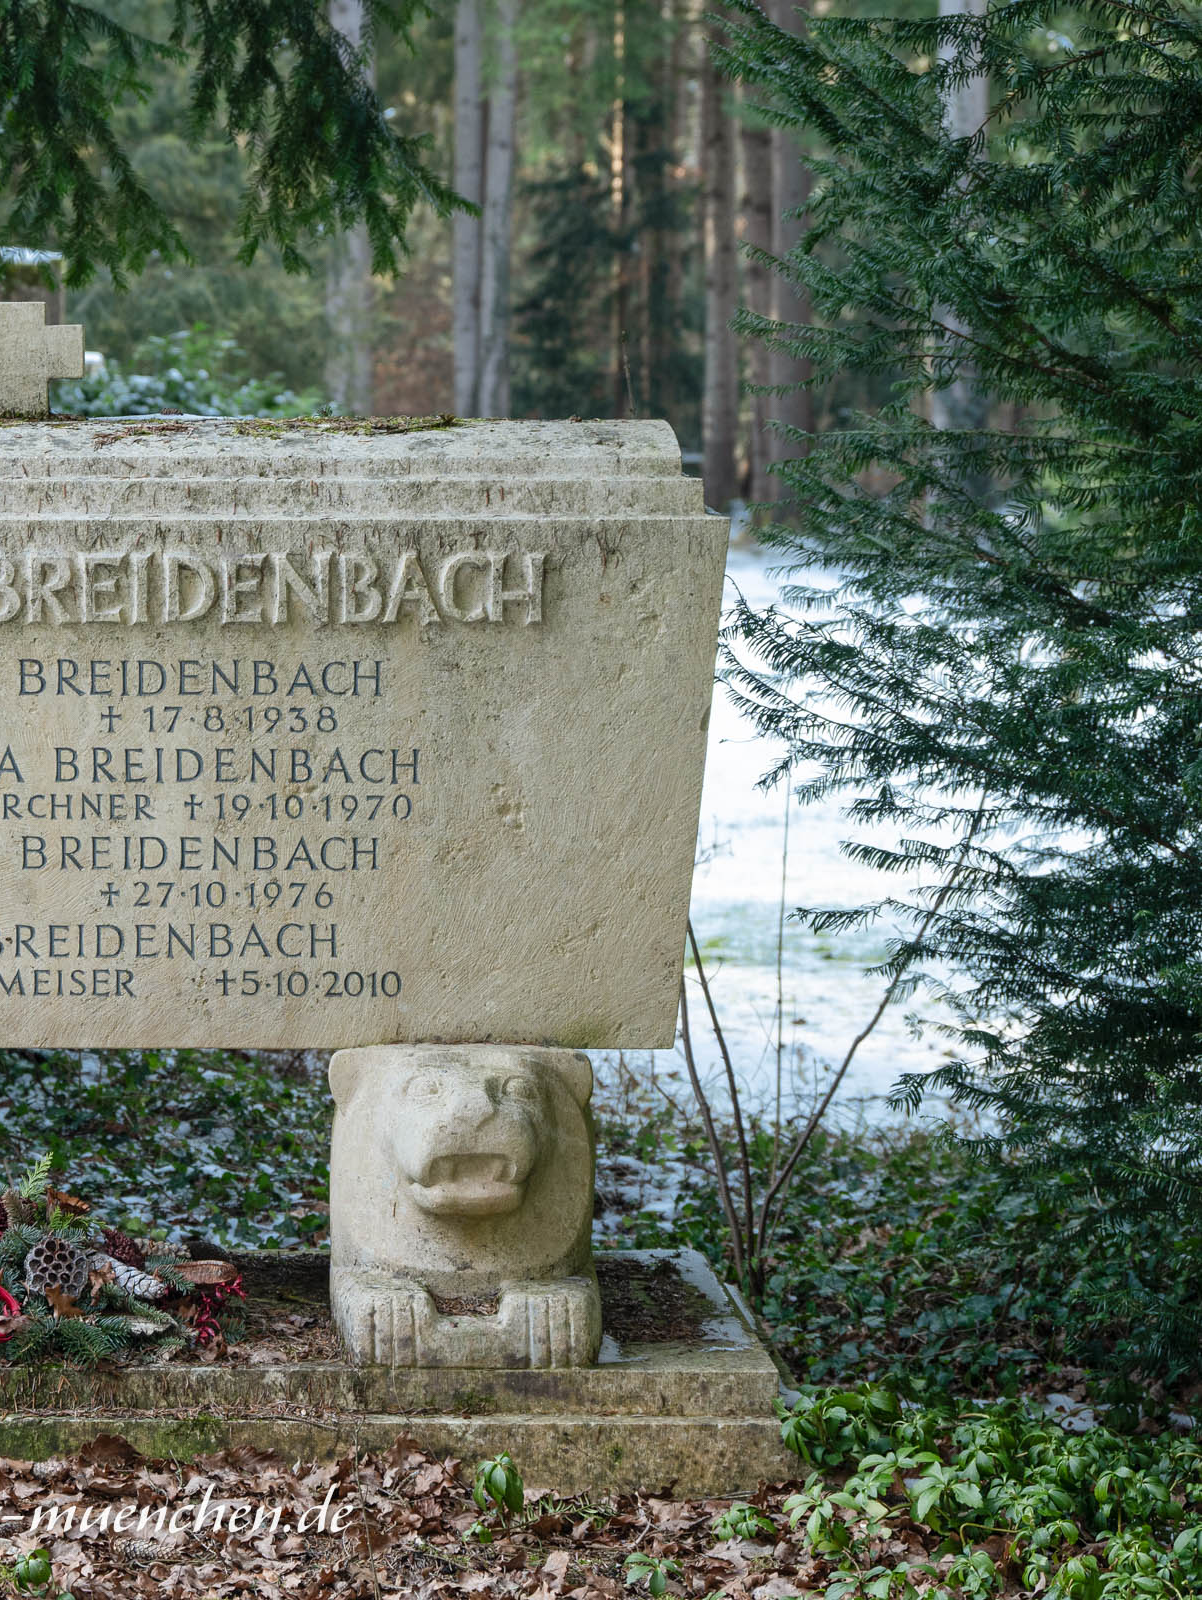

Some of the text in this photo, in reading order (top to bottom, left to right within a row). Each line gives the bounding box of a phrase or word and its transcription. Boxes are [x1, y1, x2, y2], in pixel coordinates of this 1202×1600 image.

[17, 657, 384, 698] BREIDENBACH
[54, 745, 421, 784] BREIDENBACH
[21, 835, 380, 871] BREIDENBACH
